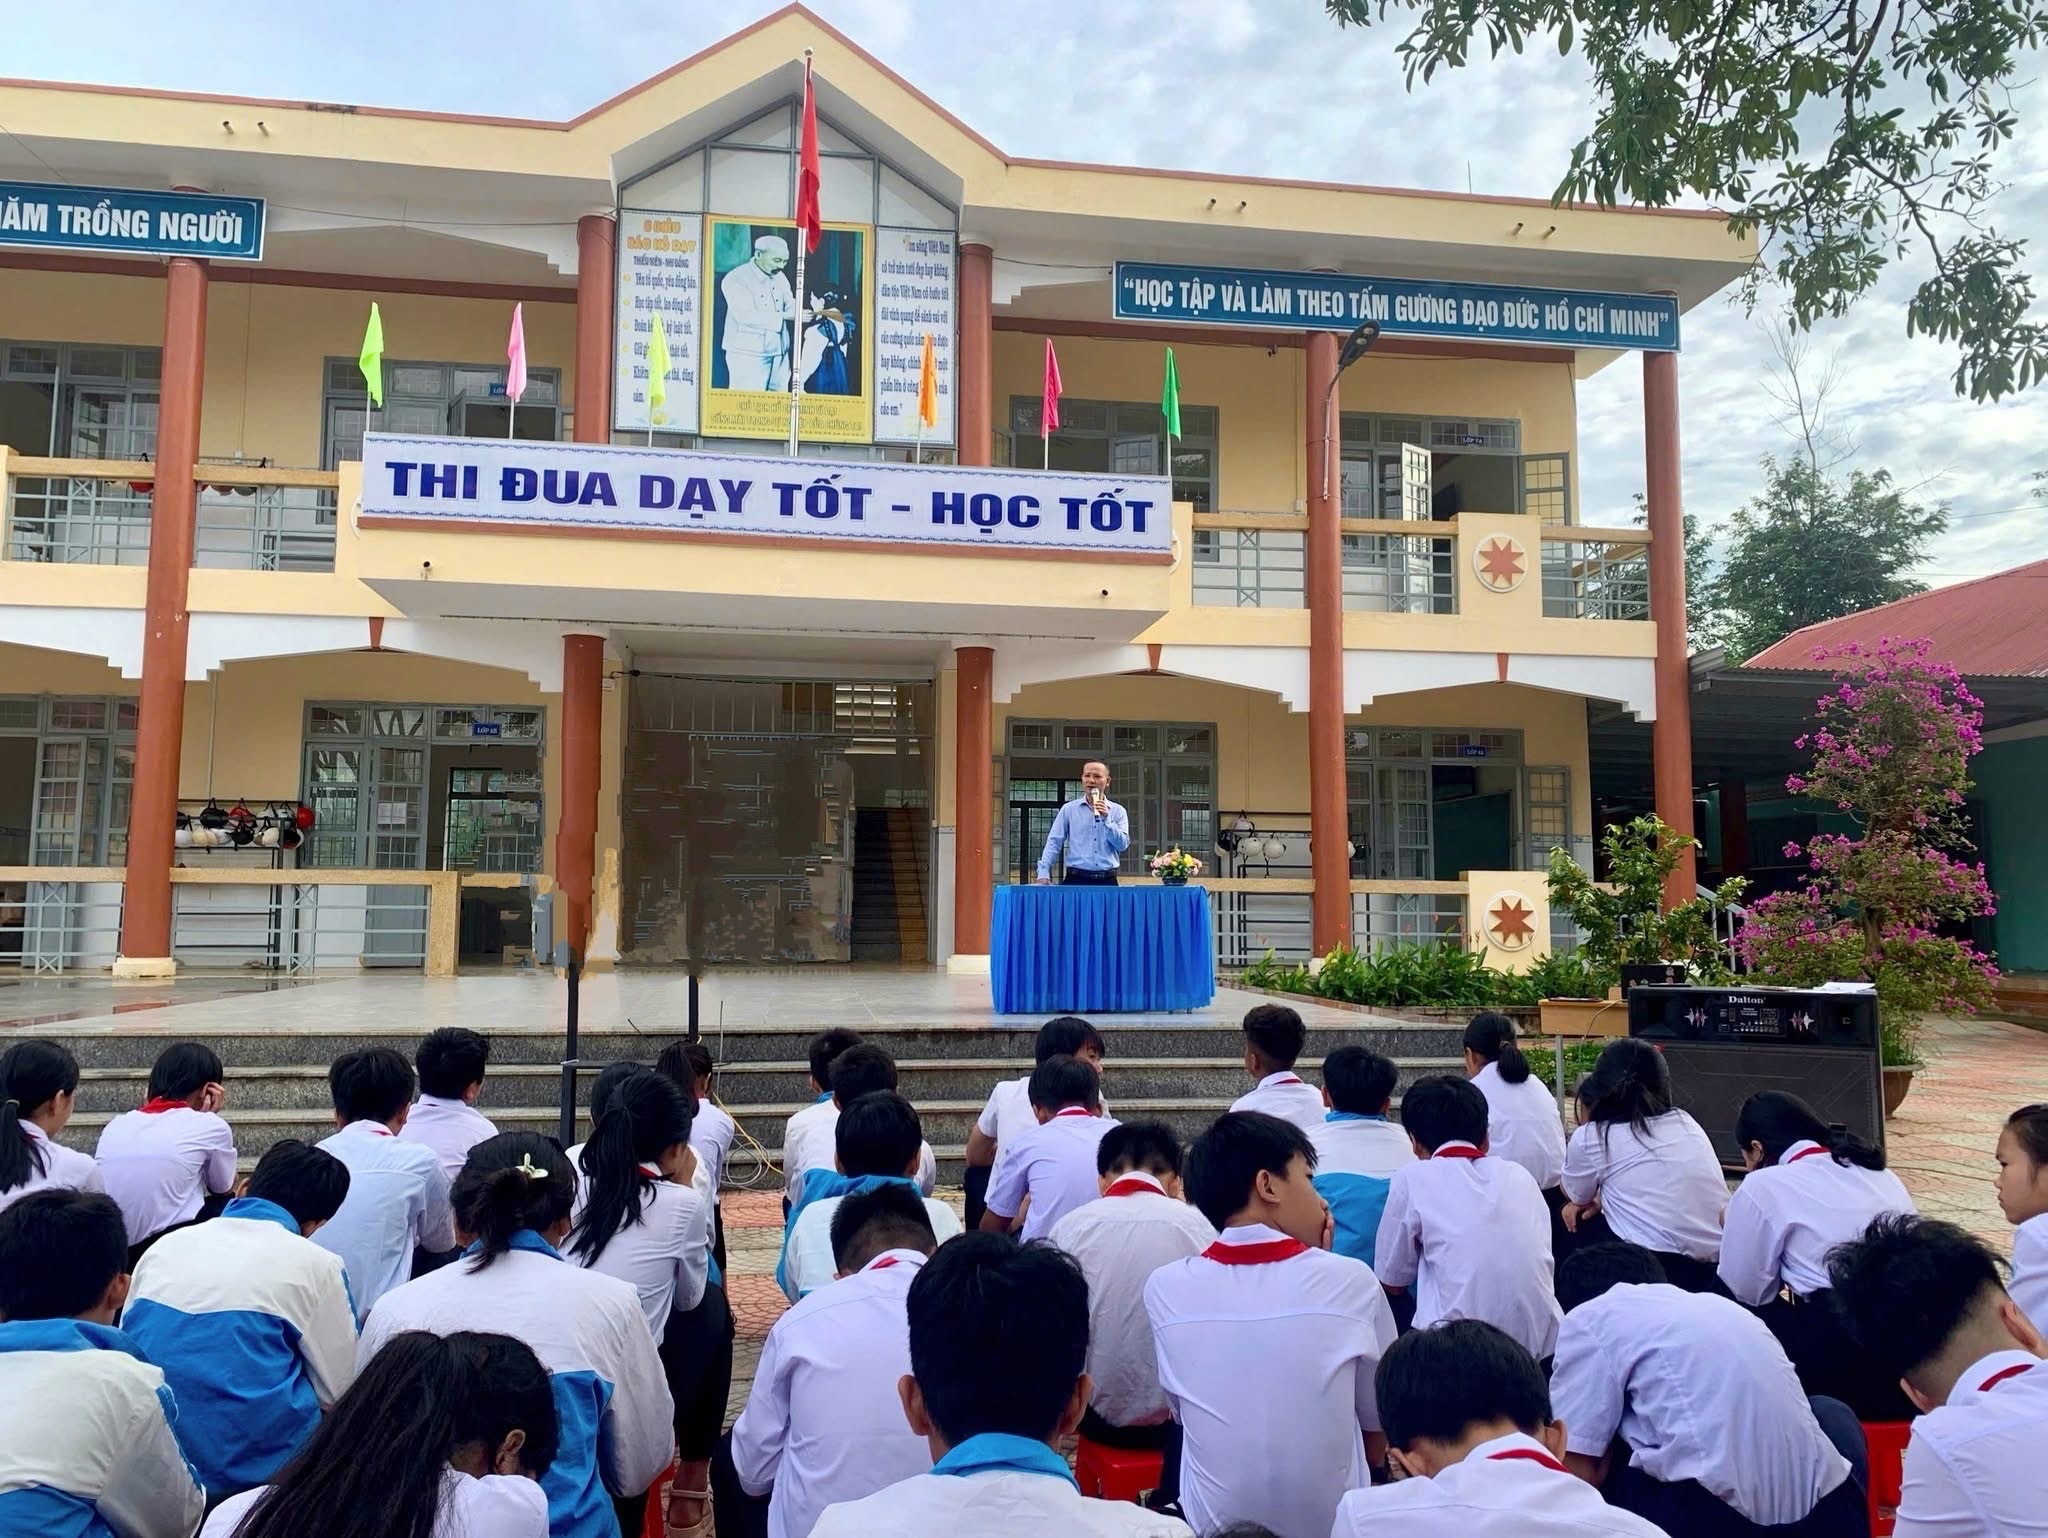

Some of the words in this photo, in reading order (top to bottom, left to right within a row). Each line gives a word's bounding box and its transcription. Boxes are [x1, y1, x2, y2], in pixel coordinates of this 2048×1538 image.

[0, 196, 48, 232] ĂM
[58, 199, 149, 239] TRỒNG
[159, 209, 242, 245] NGƯỜI
[1124, 278, 1174, 313] “HỌC
[1180, 276, 1216, 316] TẬP
[1221, 280, 1246, 312] VÀ
[1251, 280, 1291, 315] LÀM
[1297, 289, 1344, 318] THEO
[1349, 285, 1389, 321] TẤM
[1395, 293, 1456, 324] GƯƠNG
[1462, 299, 1498, 331] ĐẠO
[1503, 297, 1539, 329] ĐỨC
[1546, 298, 1569, 331] HỒ
[1574, 303, 1605, 334] CHÍ
[1610, 309, 1669, 337] MINH”
[385, 462, 478, 500] THI
[500, 467, 618, 507] ĐUA
[639, 475, 753, 519] DẠY
[772, 473, 873, 521] TỐT
[891, 503, 911, 513] -
[932, 491, 1040, 534] HỌC
[1059, 488, 1154, 533] TỐT
[1728, 995, 1764, 1004] Dalton
